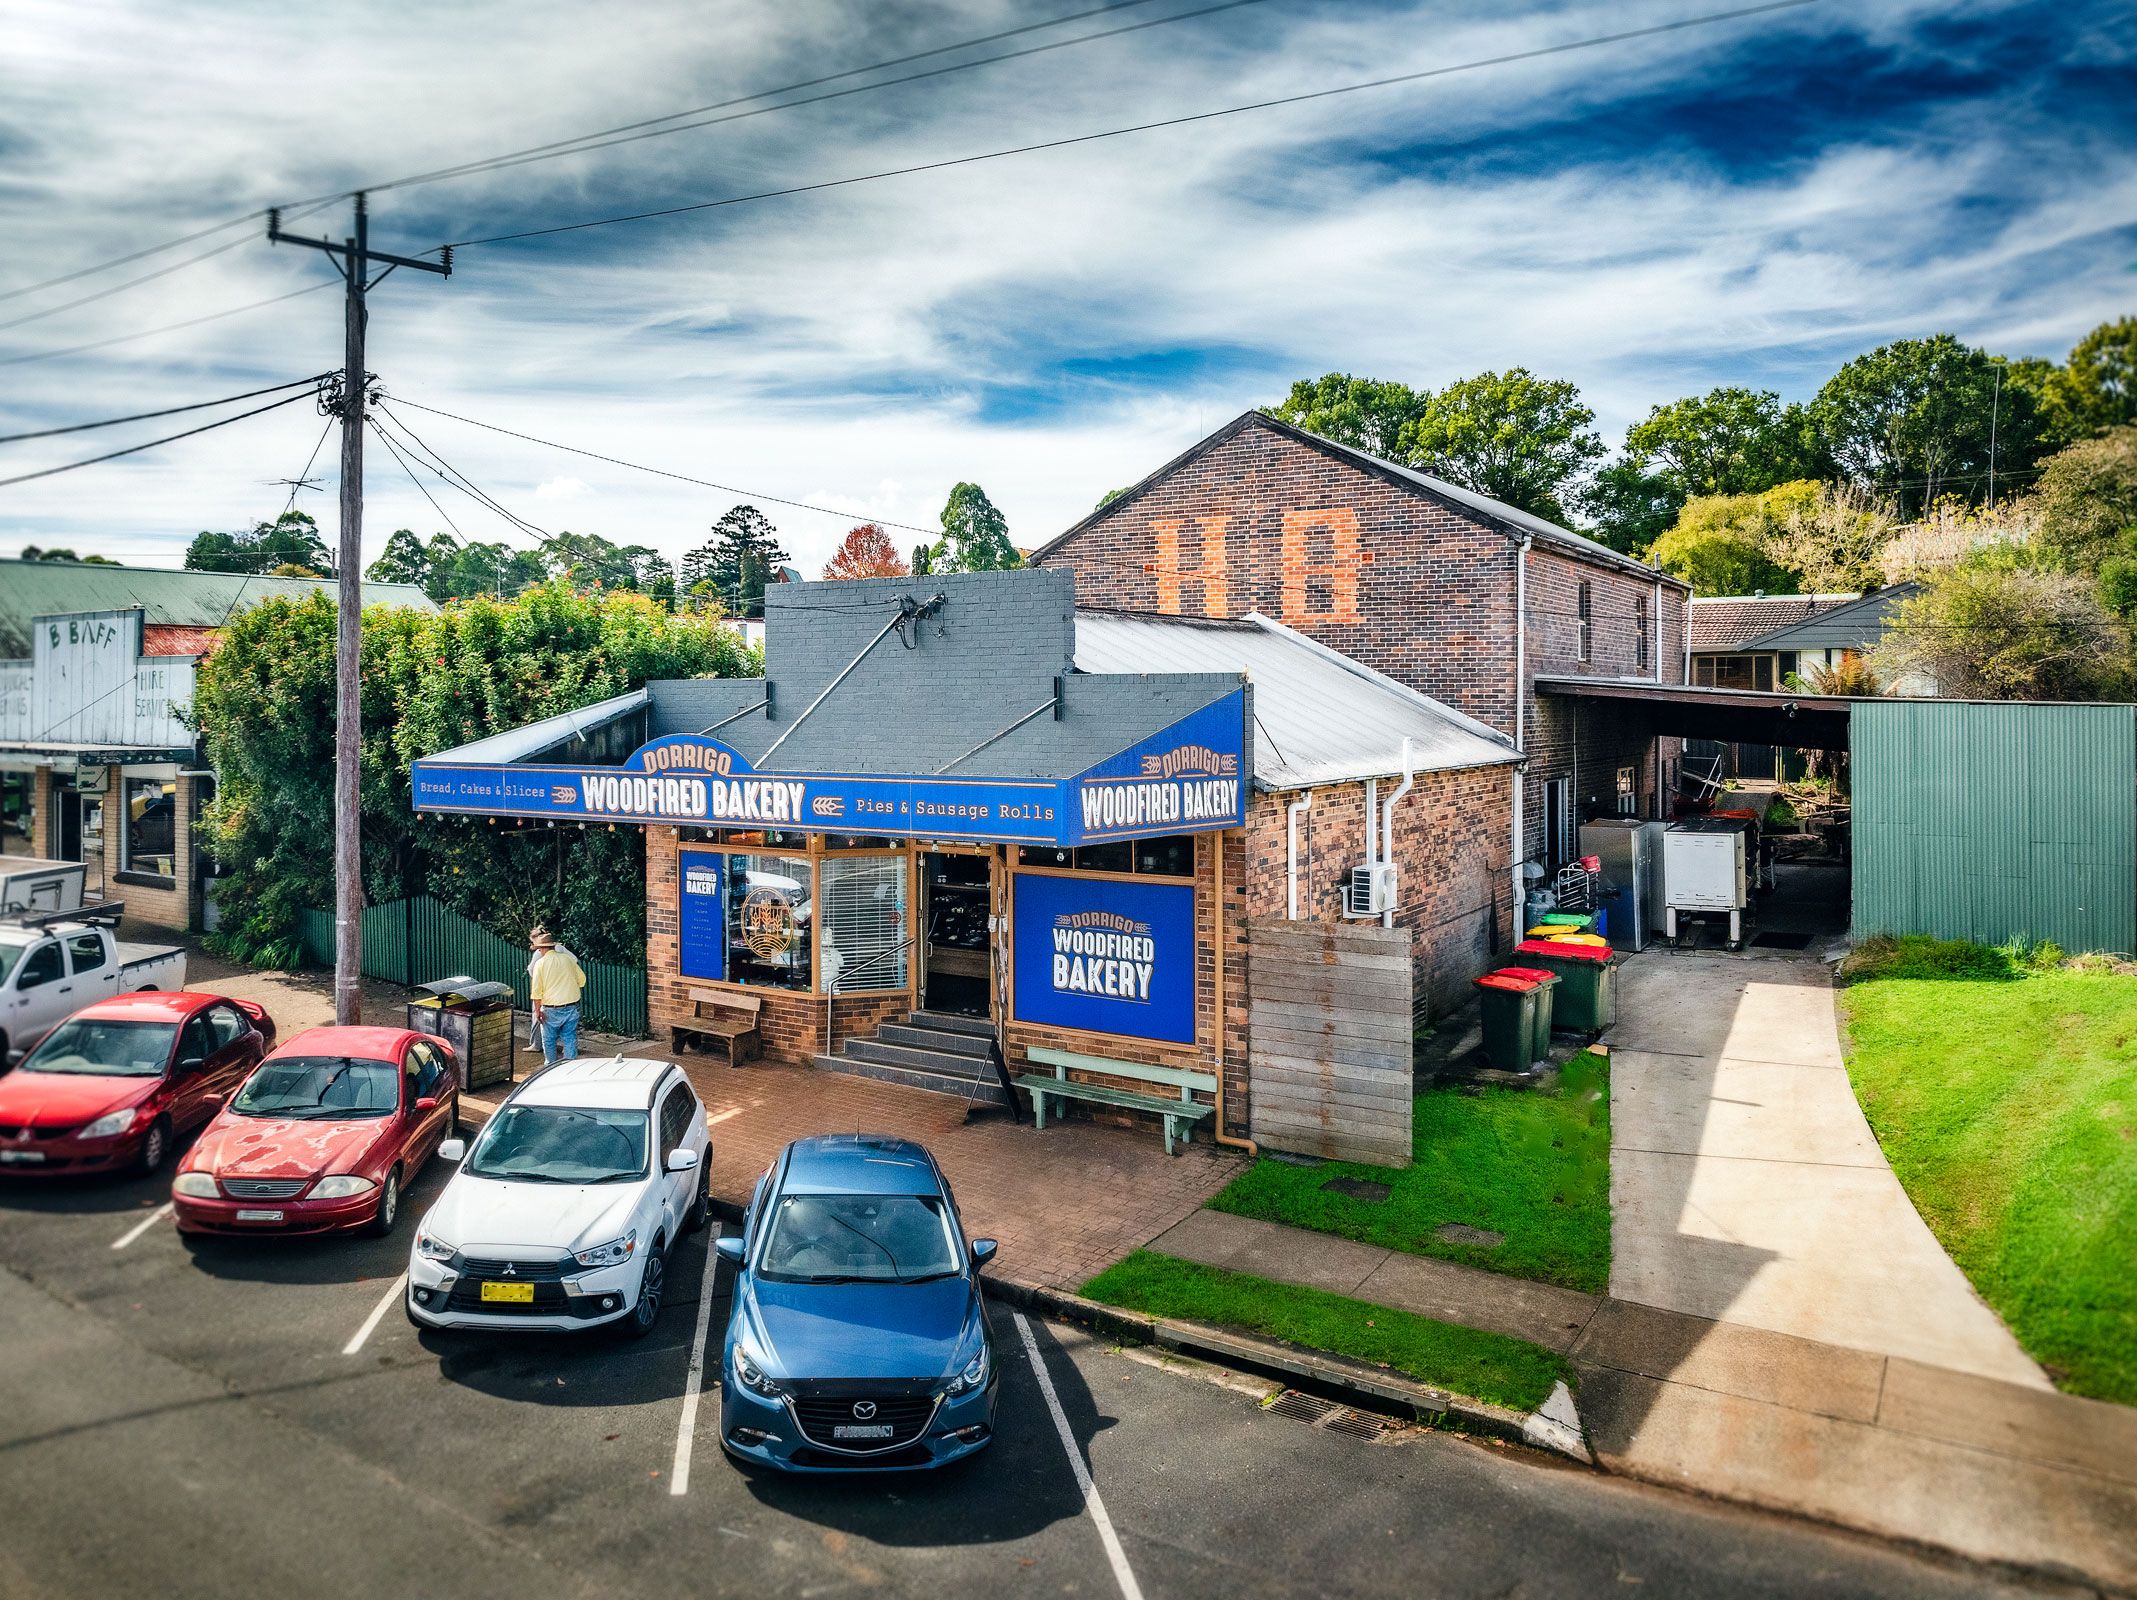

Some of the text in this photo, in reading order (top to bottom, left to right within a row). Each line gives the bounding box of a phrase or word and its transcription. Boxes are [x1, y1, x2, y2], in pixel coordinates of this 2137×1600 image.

[141, 670, 164, 690] HIRE
[642, 744, 732, 776] DORRIGO
[1162, 745, 1220, 779] DORRIGO
[420, 782, 545, 797] Bread, Cakes & Slices
[581, 775, 805, 821] WOODFIRED BAKERY
[1081, 779, 1239, 830] WOODFIRED BAKERY
[856, 798, 1054, 820] Pies & Sausage Rolls
[686, 880, 717, 895] BAKERY
[1071, 911, 1135, 934] DORRIGO
[1053, 928, 1155, 963] WOODFIRED
[1053, 953, 1153, 1000] BAKERY
